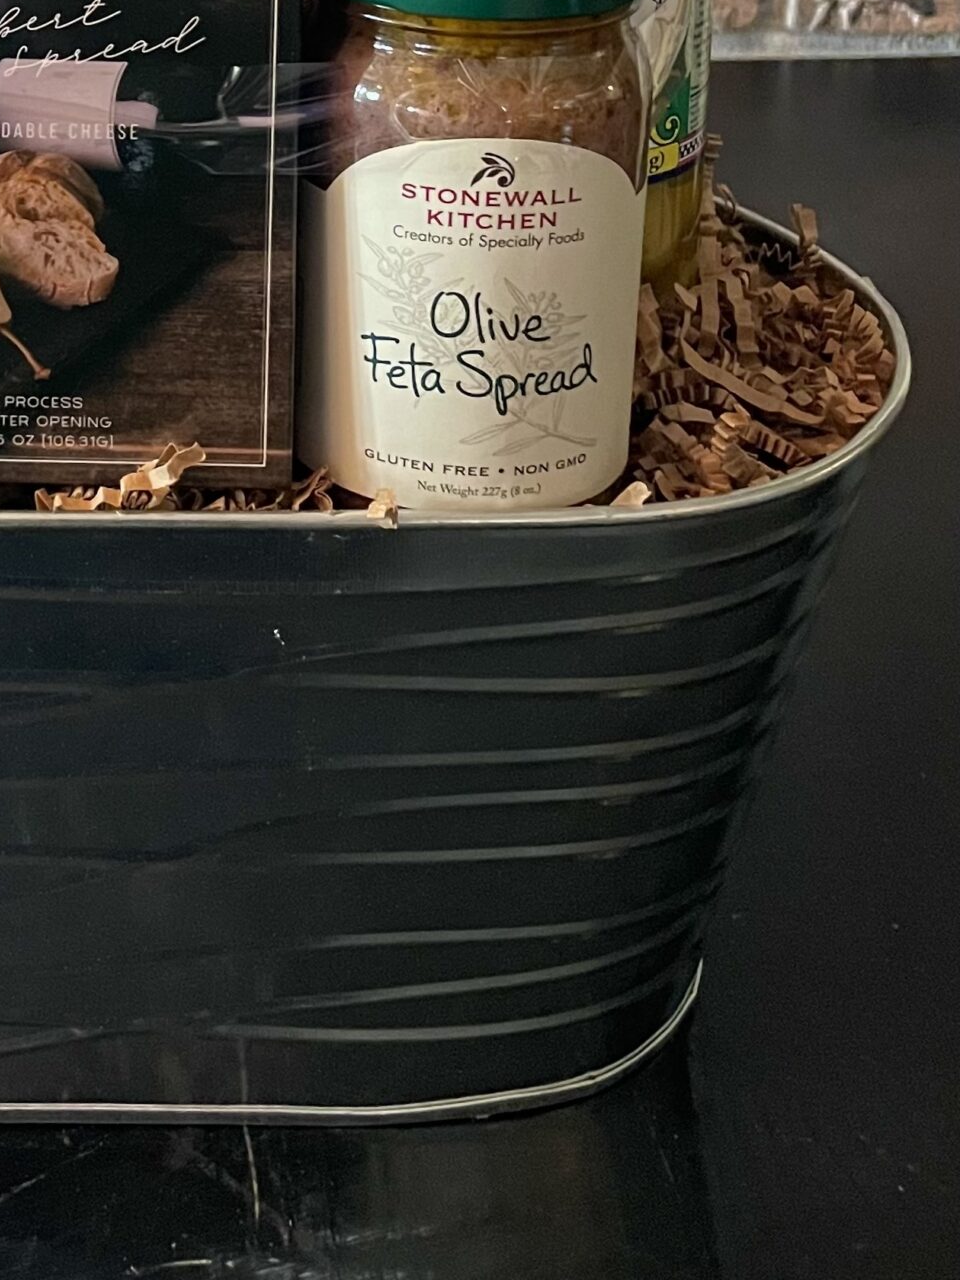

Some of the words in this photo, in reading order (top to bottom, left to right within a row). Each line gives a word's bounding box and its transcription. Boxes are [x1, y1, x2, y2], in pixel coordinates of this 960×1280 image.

[3, 16, 207, 78] Spread
[68, 123, 139, 140] CHEESE
[401, 183, 582, 207] STONEWALL
[427, 209, 557, 230] KITCHEN
[392, 224, 453, 246] Creators
[459, 233, 474, 247] of
[478, 231, 544, 251] Specialty
[548, 227, 585, 246] Foods
[430, 291, 551, 344] Olive
[361, 332, 446, 398] Feta
[456, 342, 598, 416] Spread
[4, 396, 83, 409] PROCESS
[36, 414, 112, 428] OPENING
[12, 434, 34, 446] OZ
[364, 448, 434, 472] GLUTEN
[442, 464, 490, 477] FREE
[513, 462, 549, 476] NON
[555, 453, 587, 470] GMO
[417, 480, 436, 493] Net
[440, 483, 479, 498] Weight
[481, 487, 507, 498] 227g
[510, 485, 520, 498] (8
[522, 485, 542, 497] oz.)
